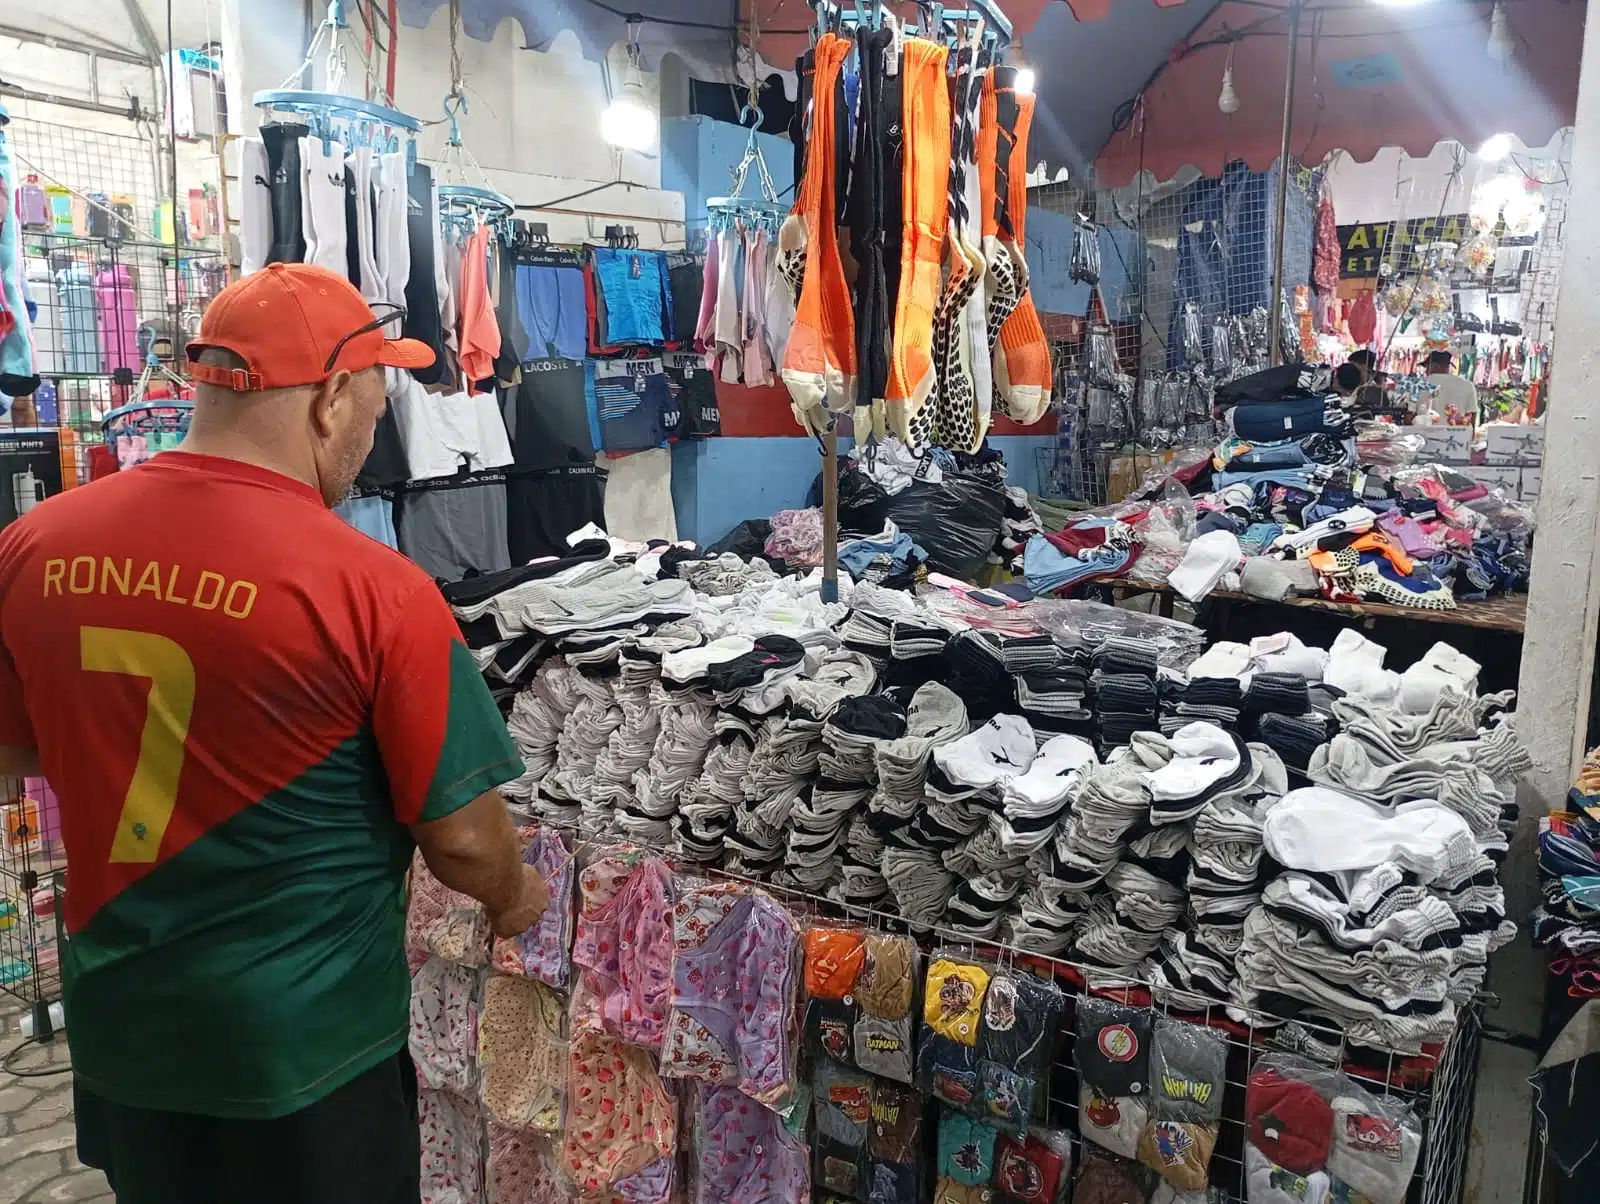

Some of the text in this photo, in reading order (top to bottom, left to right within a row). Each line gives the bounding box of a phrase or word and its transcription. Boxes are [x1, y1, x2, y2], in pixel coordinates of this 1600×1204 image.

[524, 361, 569, 373] LACOSTE
[625, 360, 656, 376] MEN
[43, 556, 258, 619] RONALDO
[80, 625, 196, 864] 7
[866, 1036, 899, 1050] BATMAN
[1162, 1075, 1212, 1104] BATMAN
